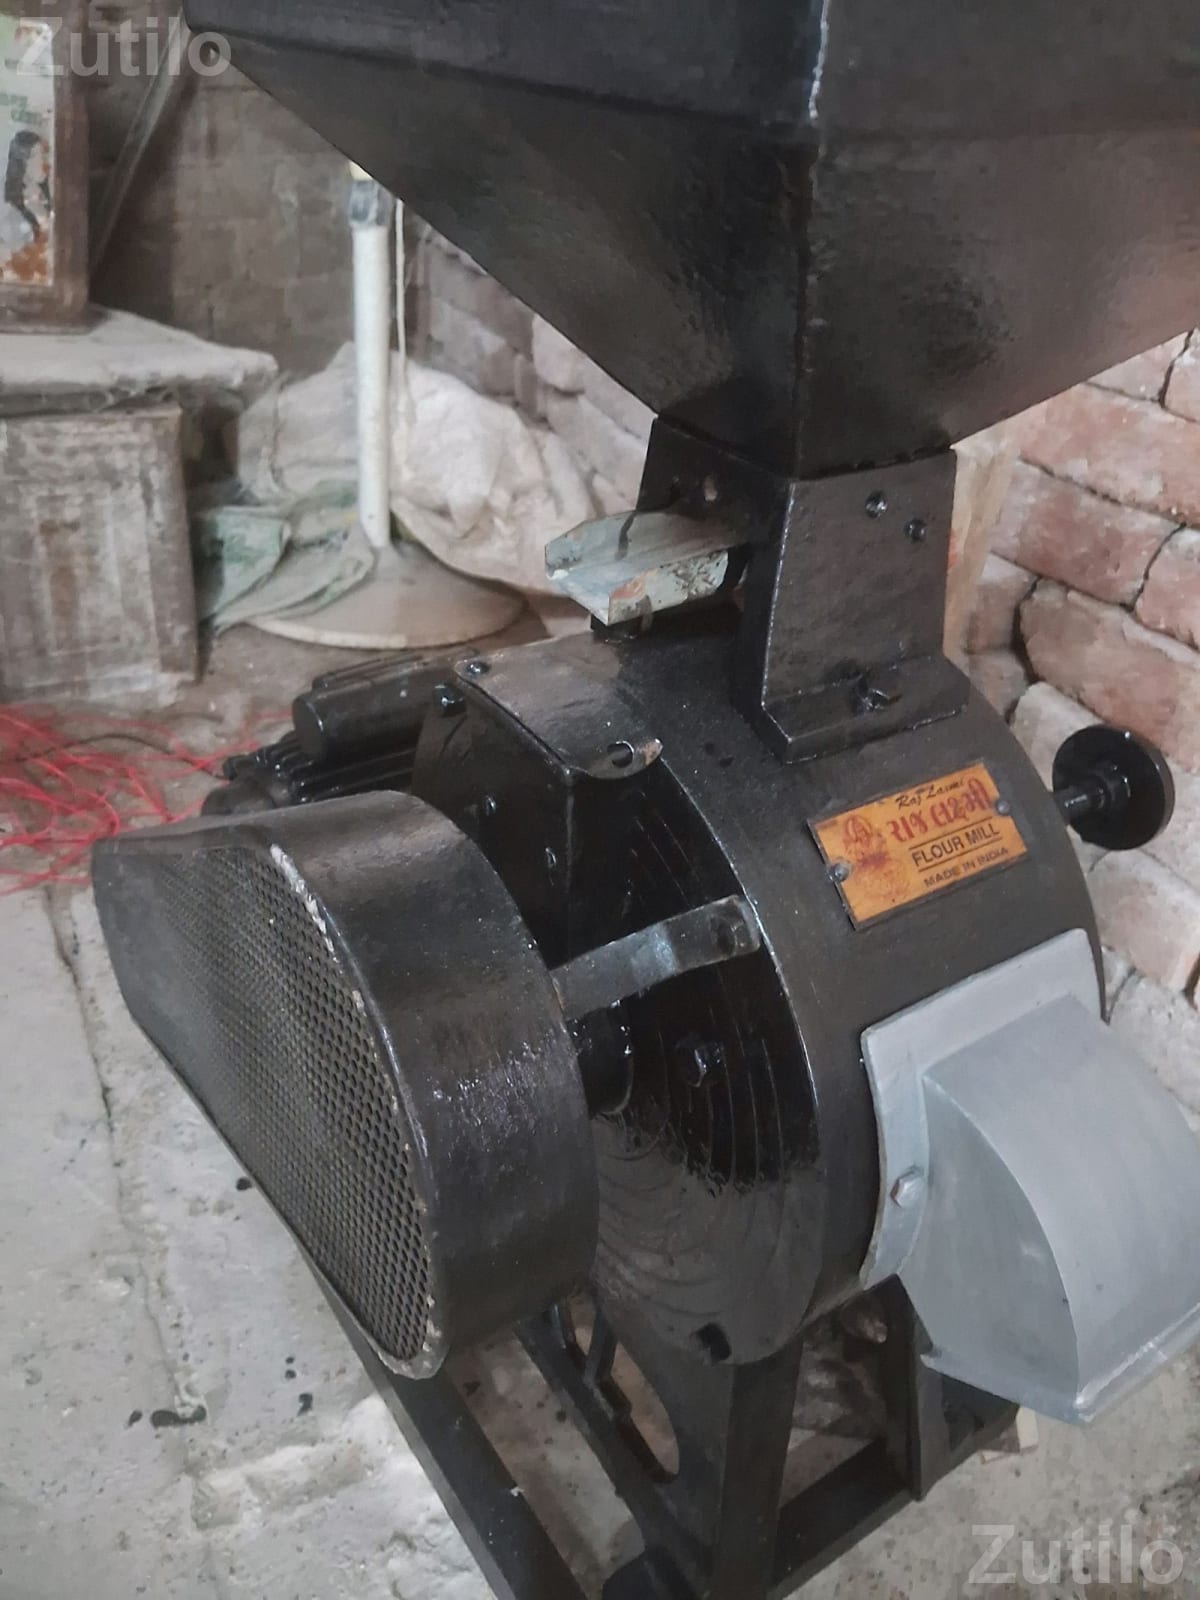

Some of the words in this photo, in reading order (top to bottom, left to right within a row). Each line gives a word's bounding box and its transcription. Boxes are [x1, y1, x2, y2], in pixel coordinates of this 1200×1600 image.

[886, 809, 928, 843] રાજ
[912, 835, 965, 868] FLOUR
[965, 823, 1000, 851] MILL
[923, 868, 961, 888] MADE
[963, 858, 977, 871] IN
[977, 847, 1009, 867] INDIA
